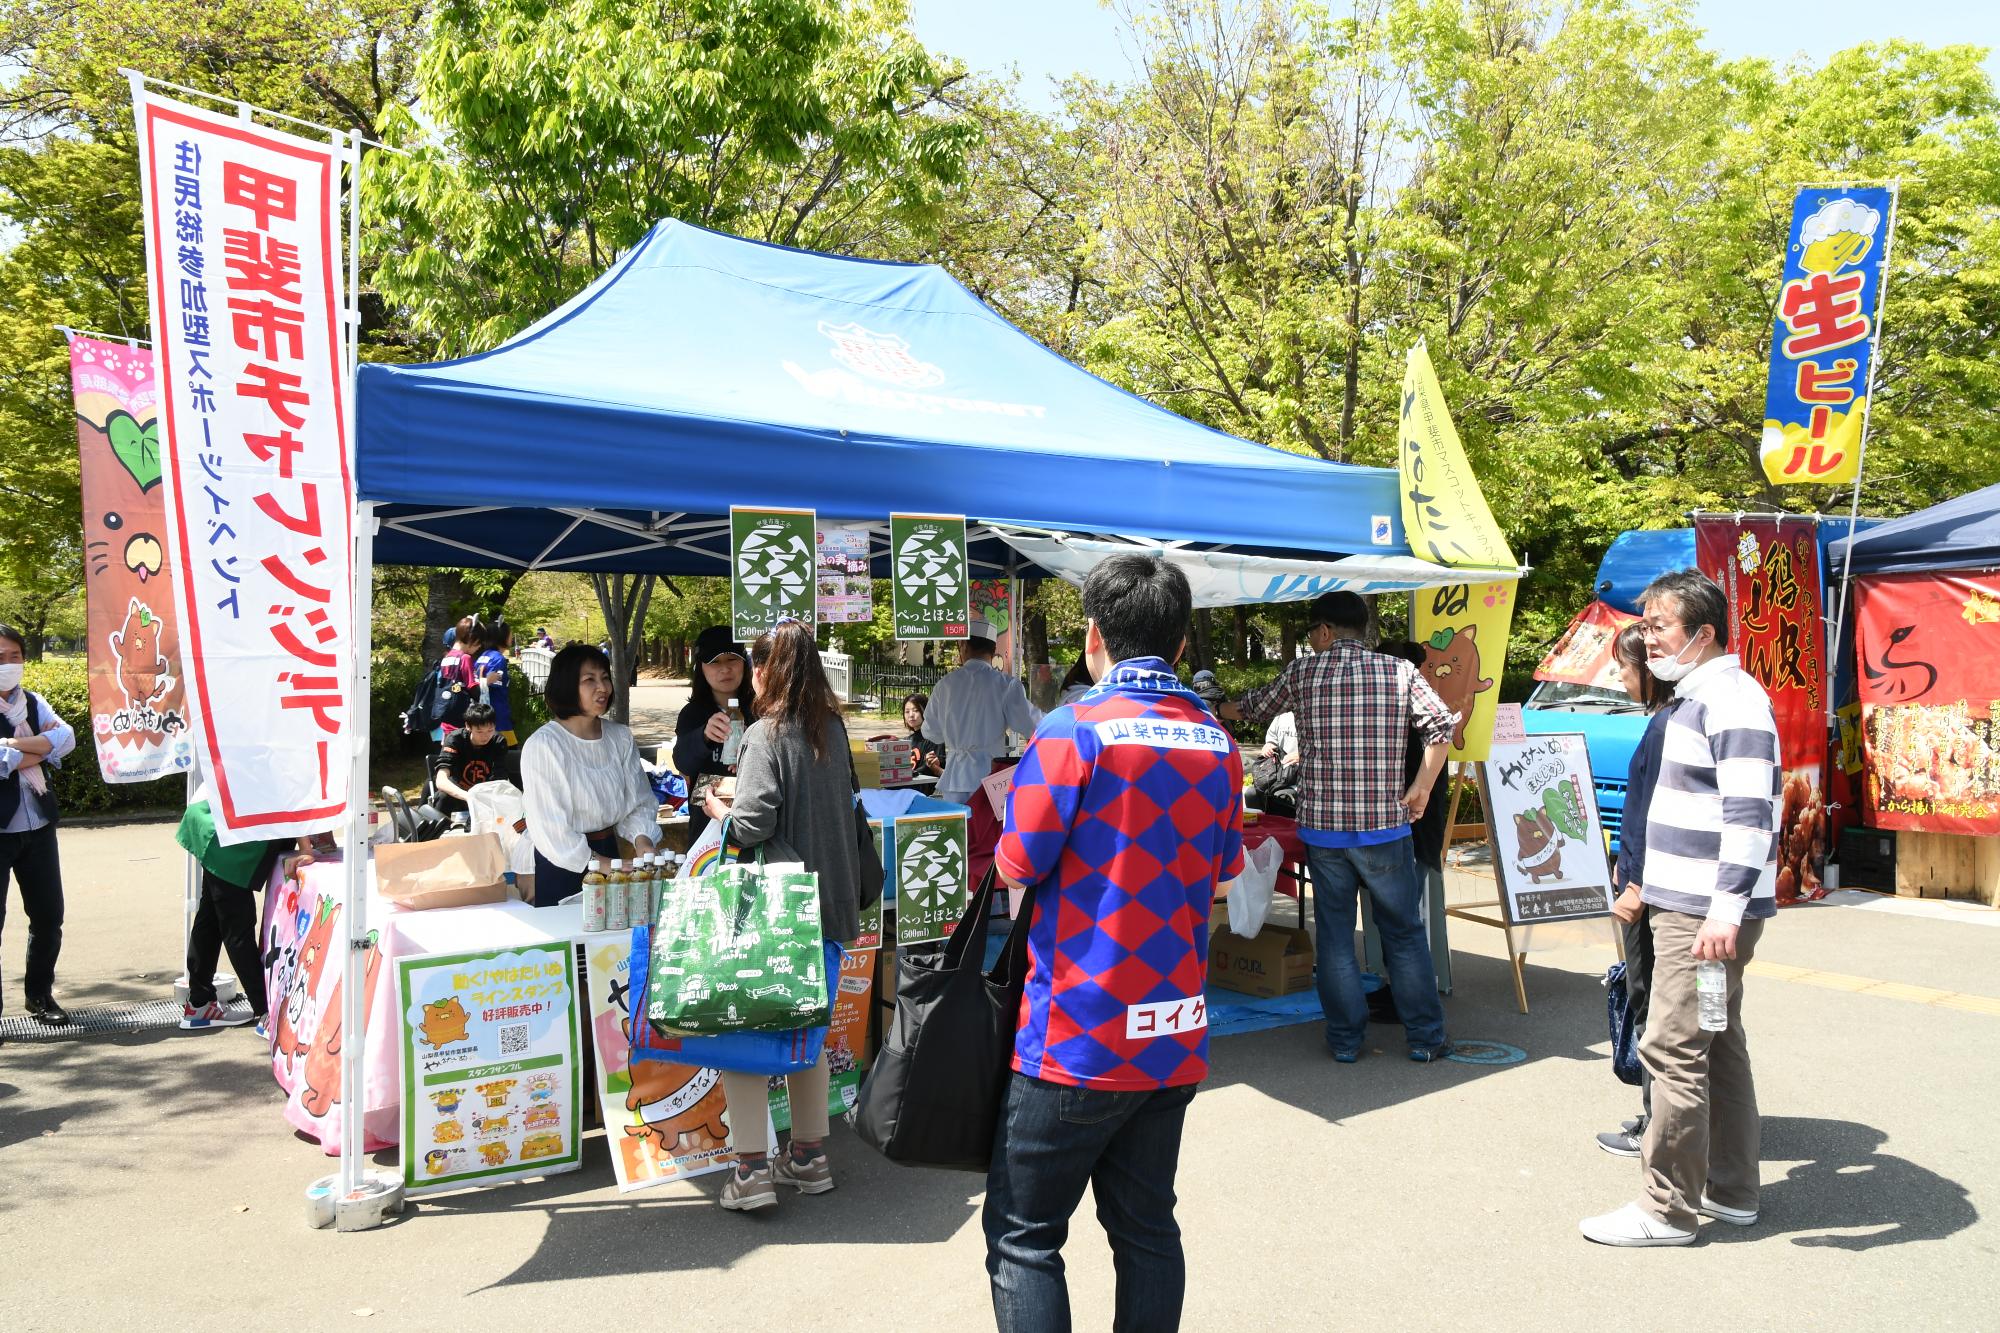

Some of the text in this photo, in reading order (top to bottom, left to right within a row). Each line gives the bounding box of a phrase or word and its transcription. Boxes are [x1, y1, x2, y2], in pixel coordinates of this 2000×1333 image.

[1780, 273, 1867, 476] 生ビール
[1738, 532, 1758, 556] 全国
[896, 608, 966, 622] ぺっとぼとる
[899, 625, 930, 635] (500ml)
[945, 626, 965, 635] 150円
[1109, 722, 1225, 747] 山梨中央銀行
[1499, 738, 1563, 791] やはたいぬ
[1526, 757, 1566, 795] まんじゅう
[1887, 800, 1989, 819] から揚げ研究会
[898, 907, 964, 924] ぺっとぼとる
[901, 928, 930, 939] (500ml)
[841, 954, 868, 970] 019
[471, 980, 564, 1006] ラインスタンプ
[1137, 1004, 1206, 1032] コイケ
[468, 1063, 522, 1078] スタンプサンプル
[674, 1156, 690, 1164] CITY
